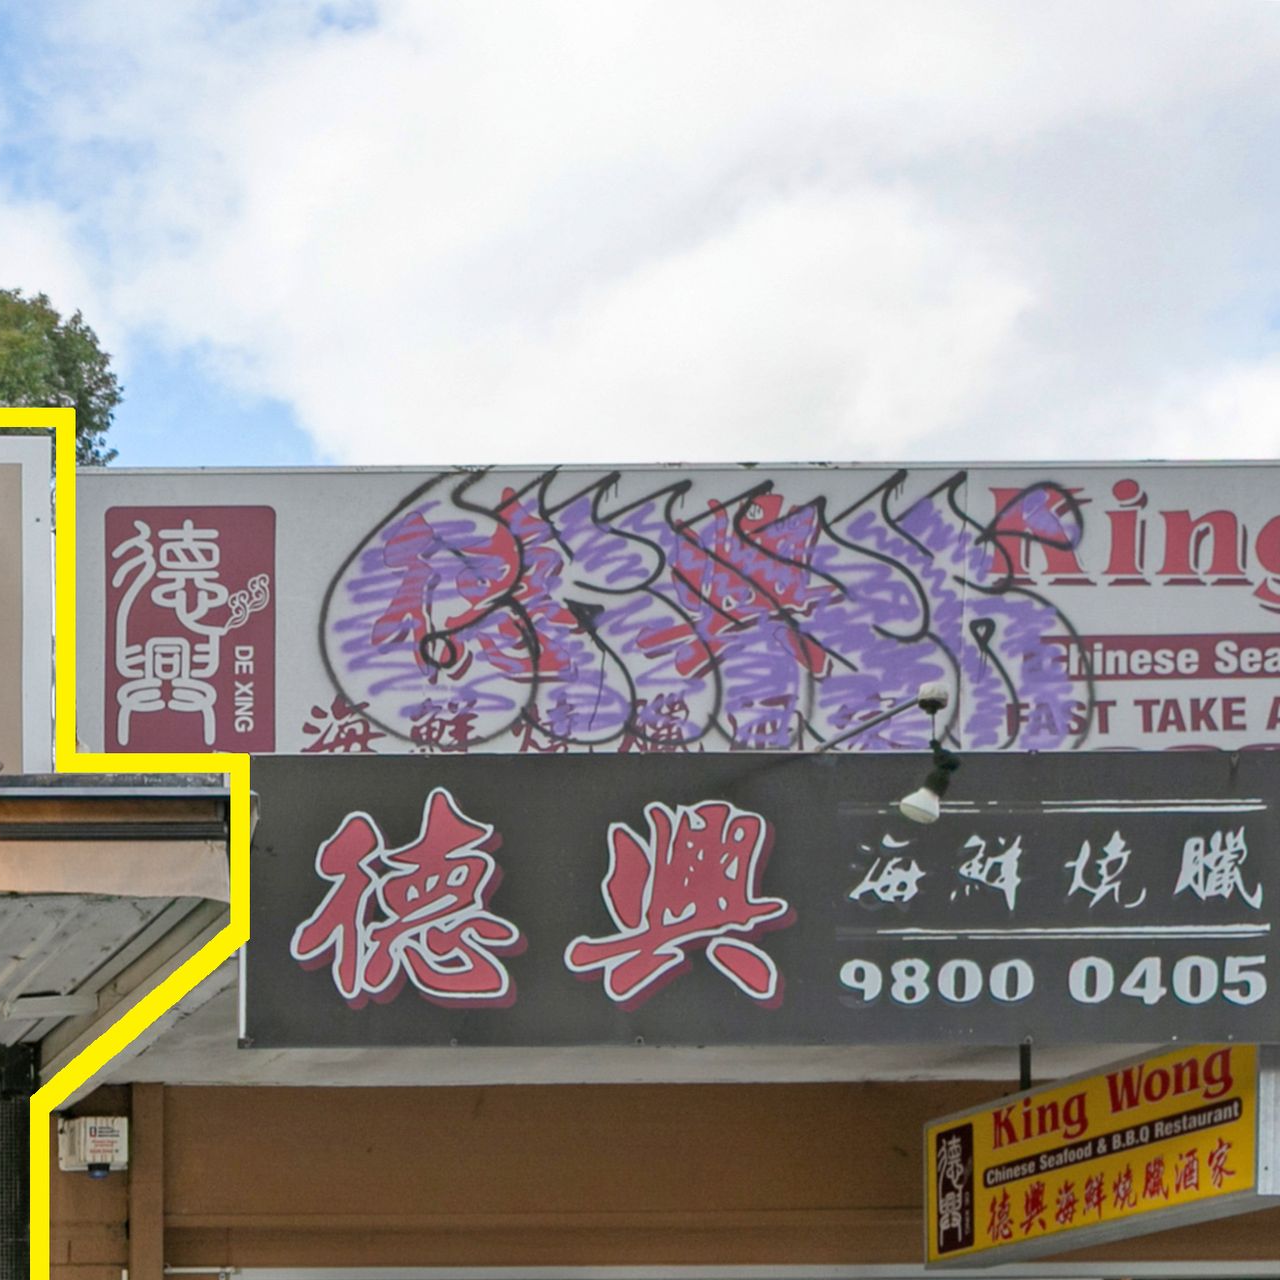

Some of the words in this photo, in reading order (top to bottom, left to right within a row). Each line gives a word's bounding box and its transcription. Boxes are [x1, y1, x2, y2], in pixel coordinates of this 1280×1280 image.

[234, 645, 255, 675] DE
[234, 680, 255, 733] XING
[1005, 698, 1118, 738] FAST
[1133, 696, 1248, 734] TAKE
[839, 957, 1035, 1005] 9800
[1067, 954, 1269, 1005] 0405
[991, 1091, 1089, 1150] King
[1105, 1046, 1234, 1115] Wong
[985, 1160, 1037, 1186] Chinese
[1038, 1142, 1093, 1170] Seafood
[1096, 1138, 1108, 1154] &
[1154, 1100, 1241, 1138] Restaurant
